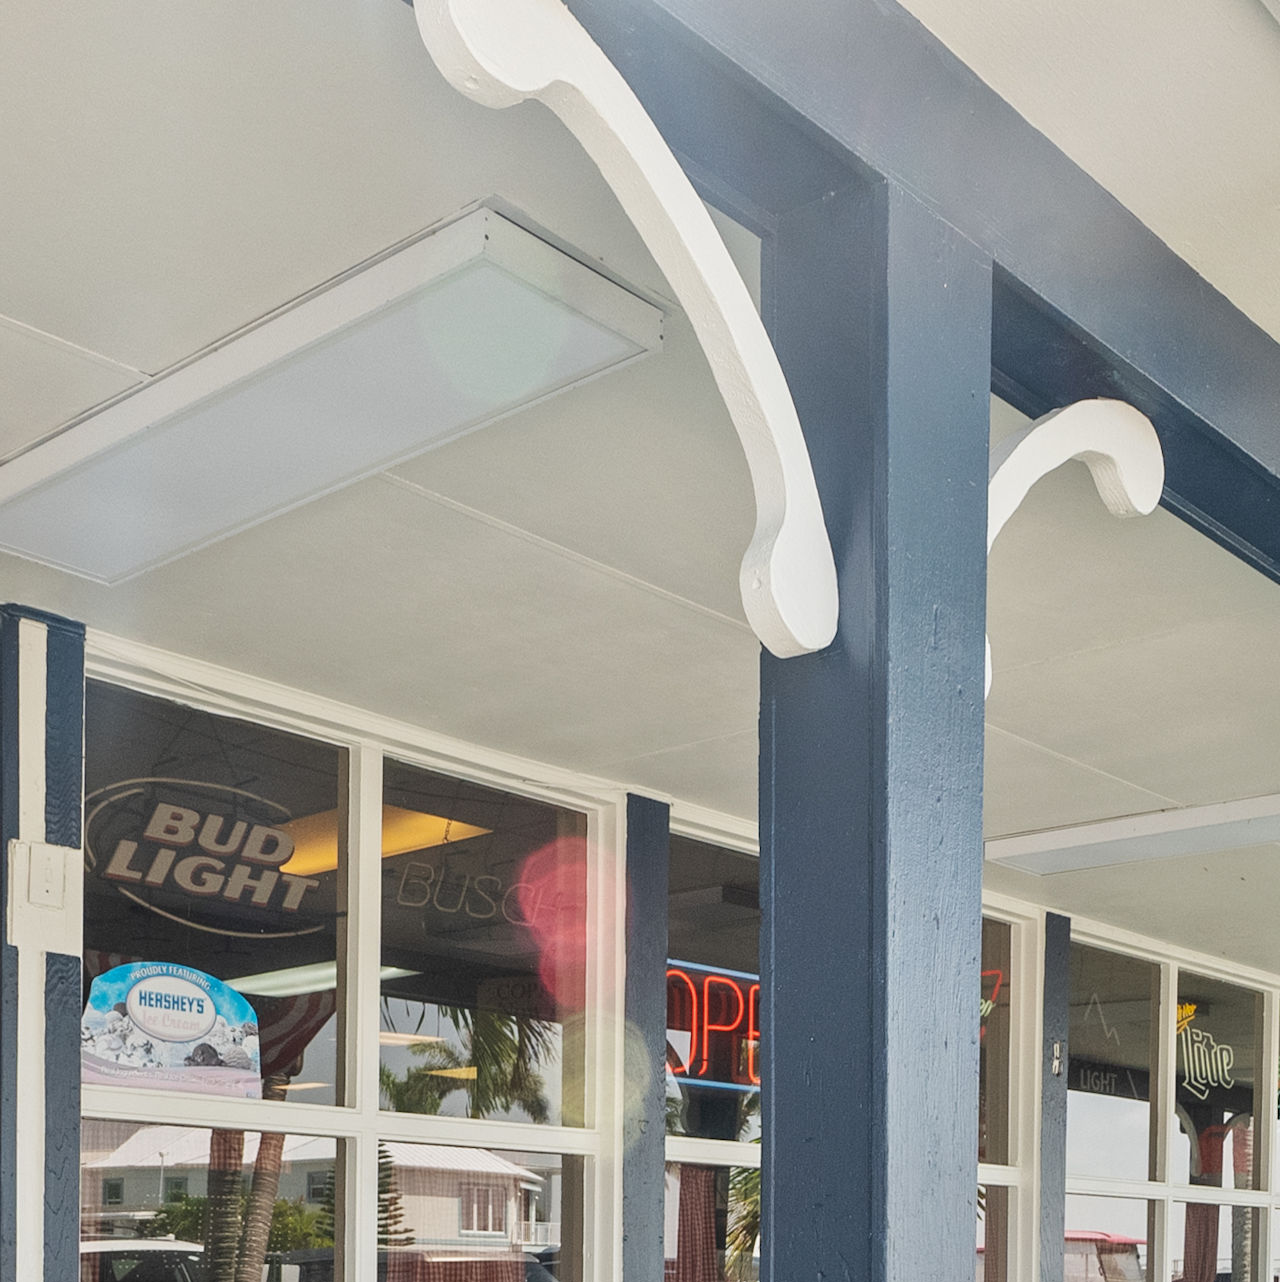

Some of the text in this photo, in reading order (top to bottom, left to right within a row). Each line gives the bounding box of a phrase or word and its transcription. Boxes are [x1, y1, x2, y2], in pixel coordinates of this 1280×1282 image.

[144, 803, 295, 866] BUD
[104, 839, 320, 913] LIGHT
[130, 965, 212, 991] PROUDLY FEATURING
[138, 990, 205, 1014] HERSHEY'S
[1080, 1069, 1118, 1093] LIGHT
[1182, 1025, 1234, 1100] Lite
